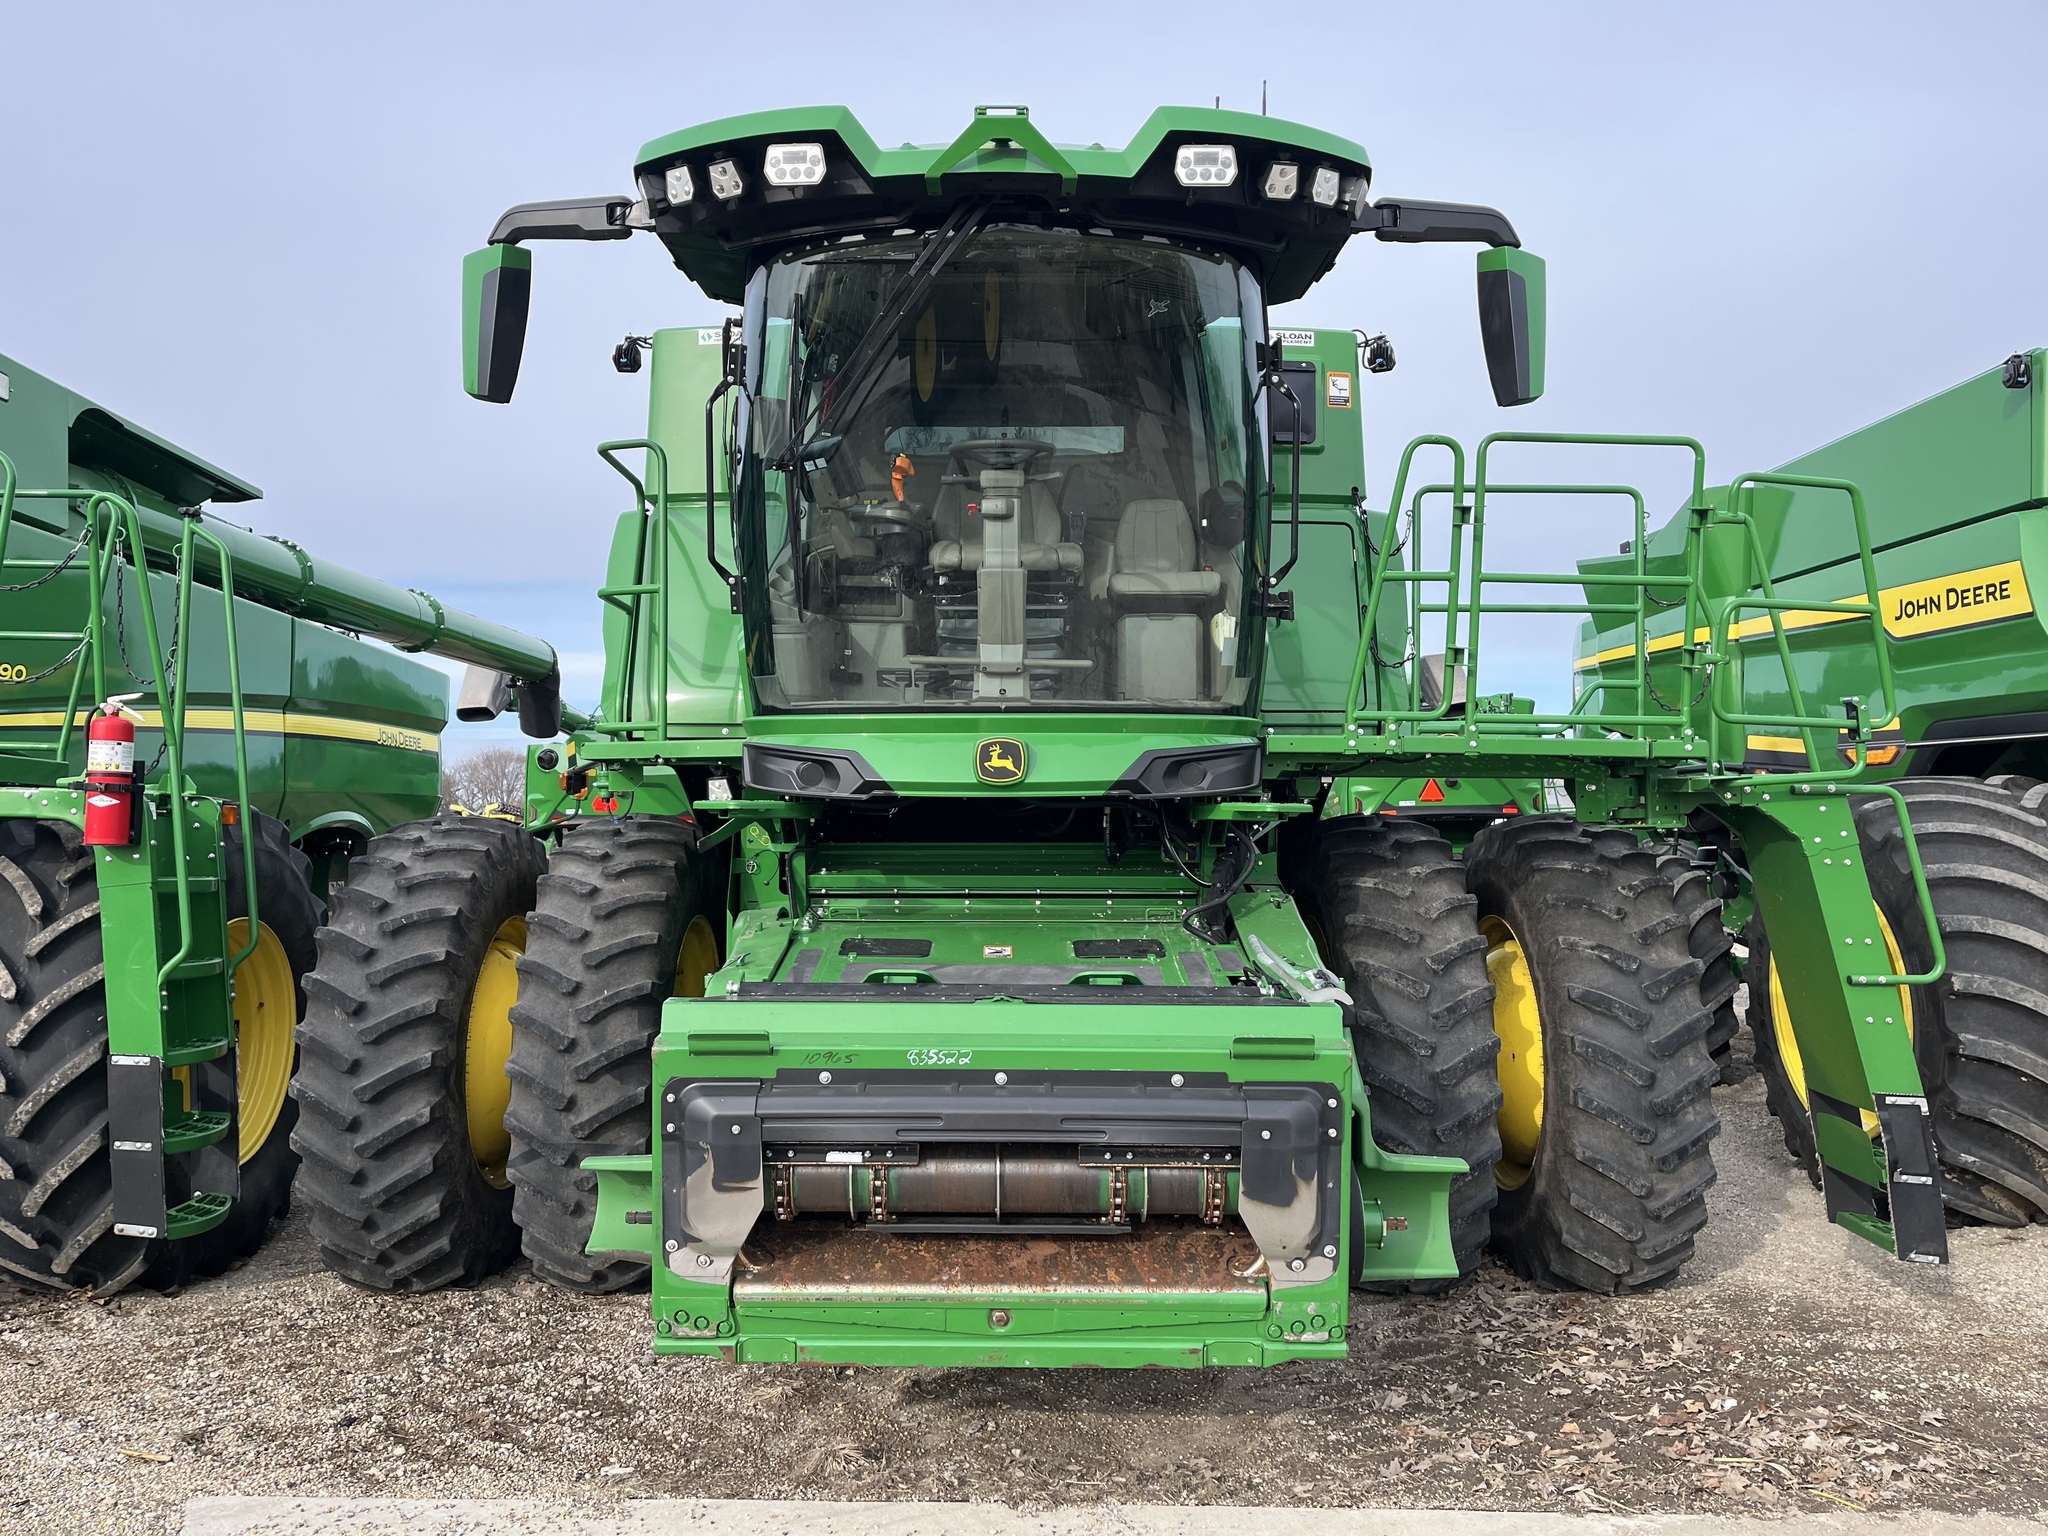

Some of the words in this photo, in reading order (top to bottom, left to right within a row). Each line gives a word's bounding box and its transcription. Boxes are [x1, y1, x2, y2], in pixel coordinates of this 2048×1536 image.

[1275, 332, 1312, 340] SLOAN
[1894, 594, 1942, 621] JOHN
[1945, 579, 2011, 611] DEERE
[377, 728, 398, 745] JOHN
[398, 731, 422, 749] DEERE
